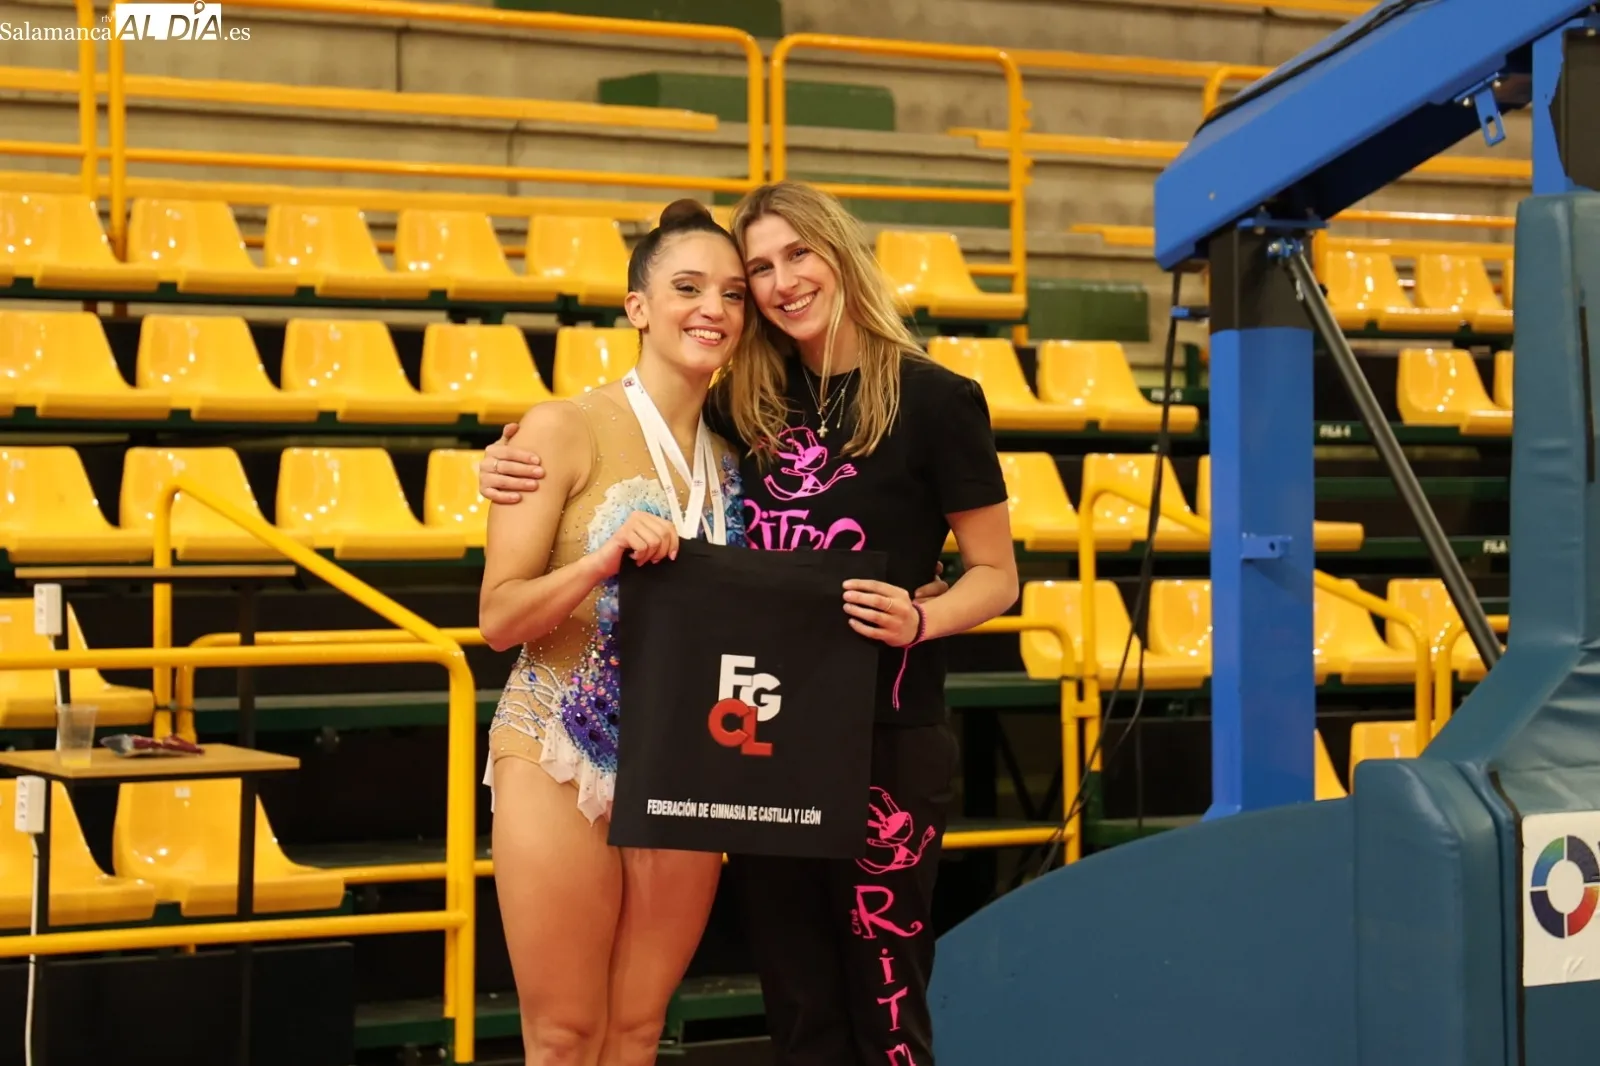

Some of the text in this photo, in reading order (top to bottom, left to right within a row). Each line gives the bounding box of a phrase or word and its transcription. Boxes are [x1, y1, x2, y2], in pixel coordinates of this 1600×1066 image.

[647, 798, 822, 825] FEDERACIÓN DE GIMNASIA DE CASTILLA Y LEÓN
